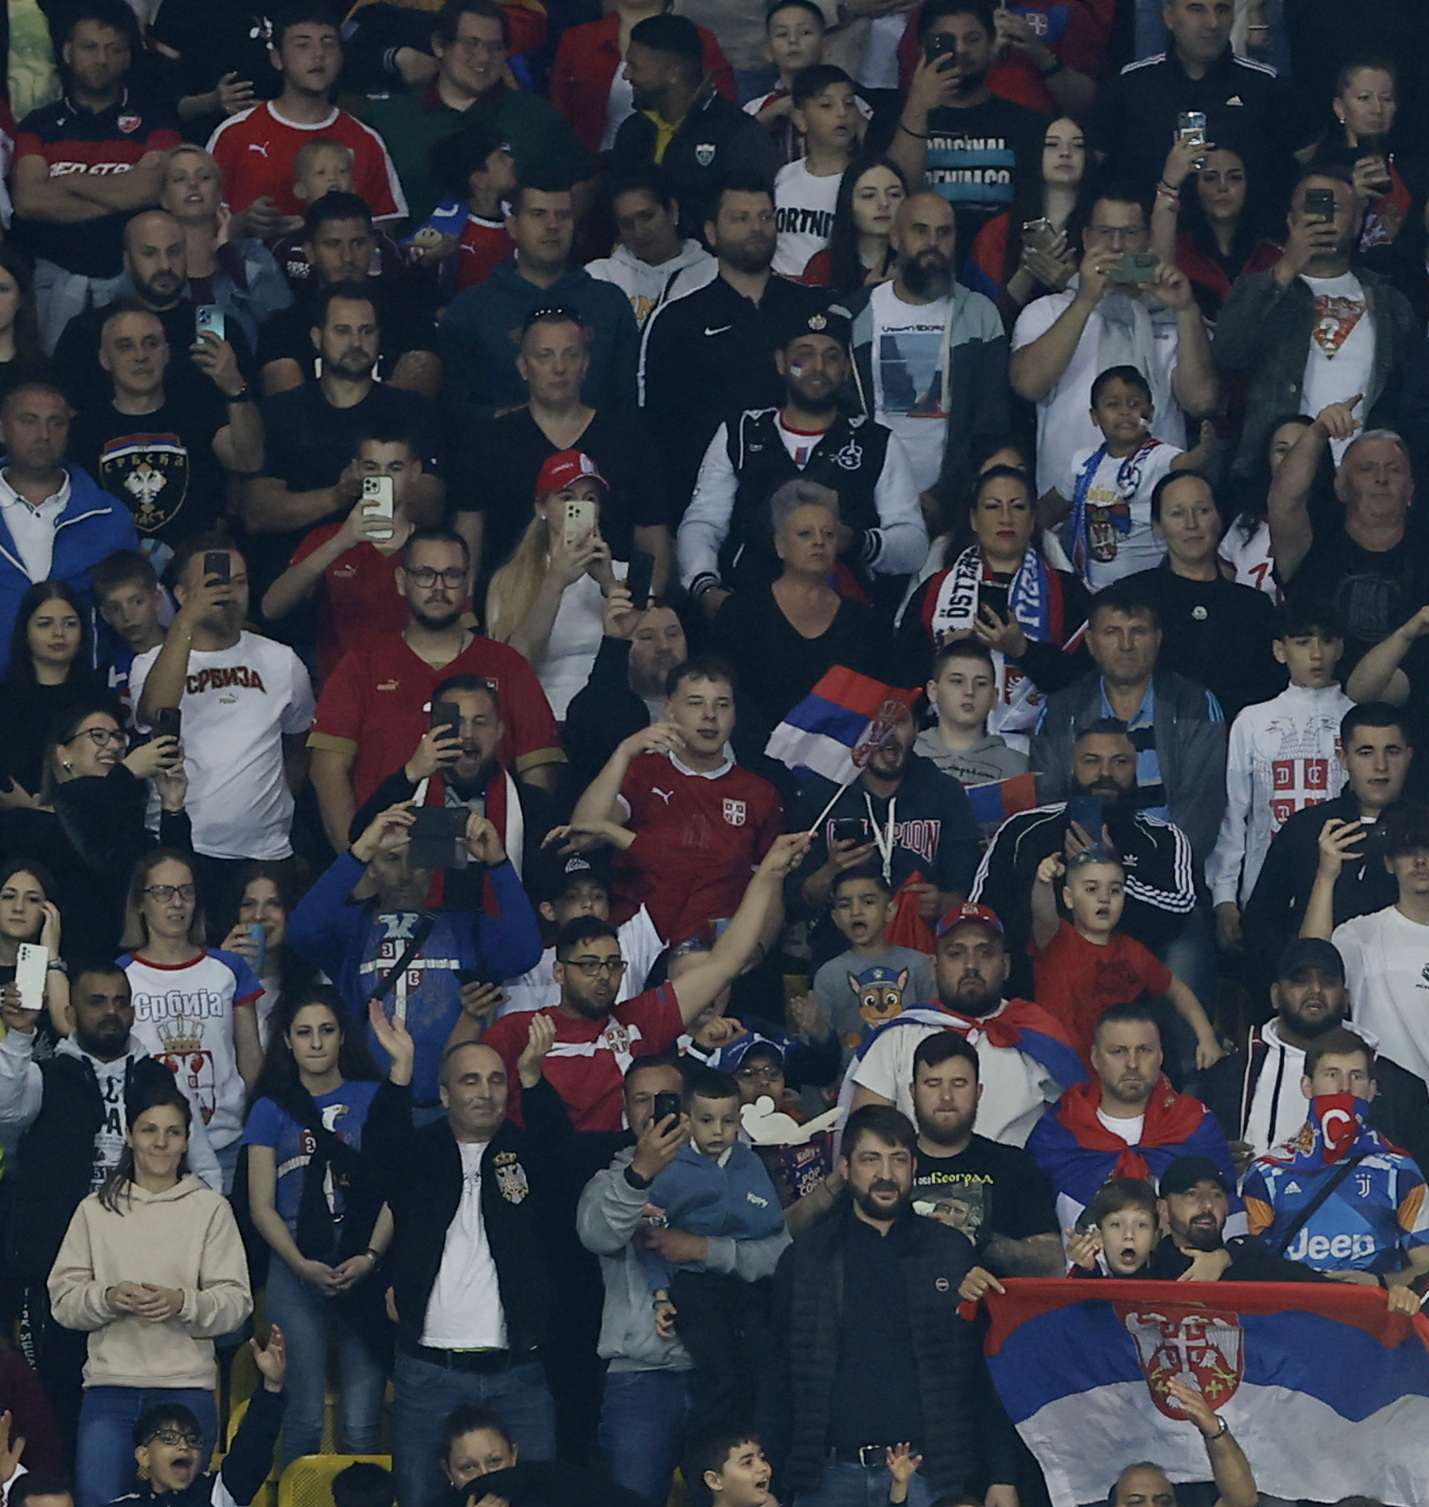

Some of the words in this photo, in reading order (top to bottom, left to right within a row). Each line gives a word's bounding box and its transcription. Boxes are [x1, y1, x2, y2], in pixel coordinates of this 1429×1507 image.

[777, 207, 834, 239] ORTNI
[187, 666, 267, 695] СРБИЈА
[134, 989, 224, 1022] Србија
[1287, 1231, 1377, 1264] Jeep
